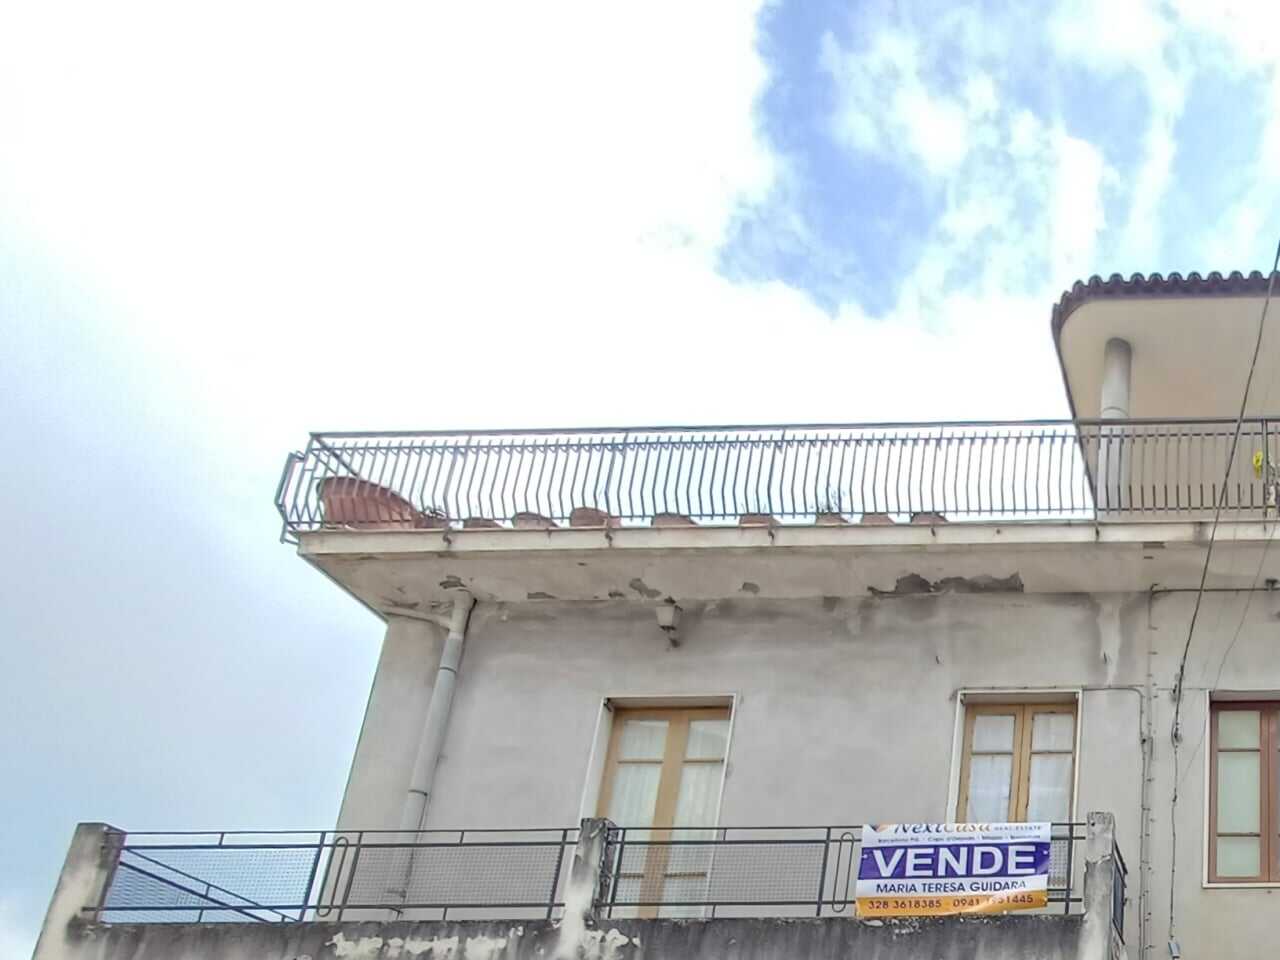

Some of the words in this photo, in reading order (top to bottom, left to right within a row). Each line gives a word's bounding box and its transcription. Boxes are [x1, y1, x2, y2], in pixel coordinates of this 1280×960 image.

[872, 845, 1036, 877] VENDE
[876, 883, 917, 893] MARIA
[922, 882, 966, 893] TERESA
[970, 881, 1026, 892] GUIDARA
[868, 900, 889, 910] 328
[892, 899, 942, 909] 3618385
[953, 898, 980, 907] 0941
